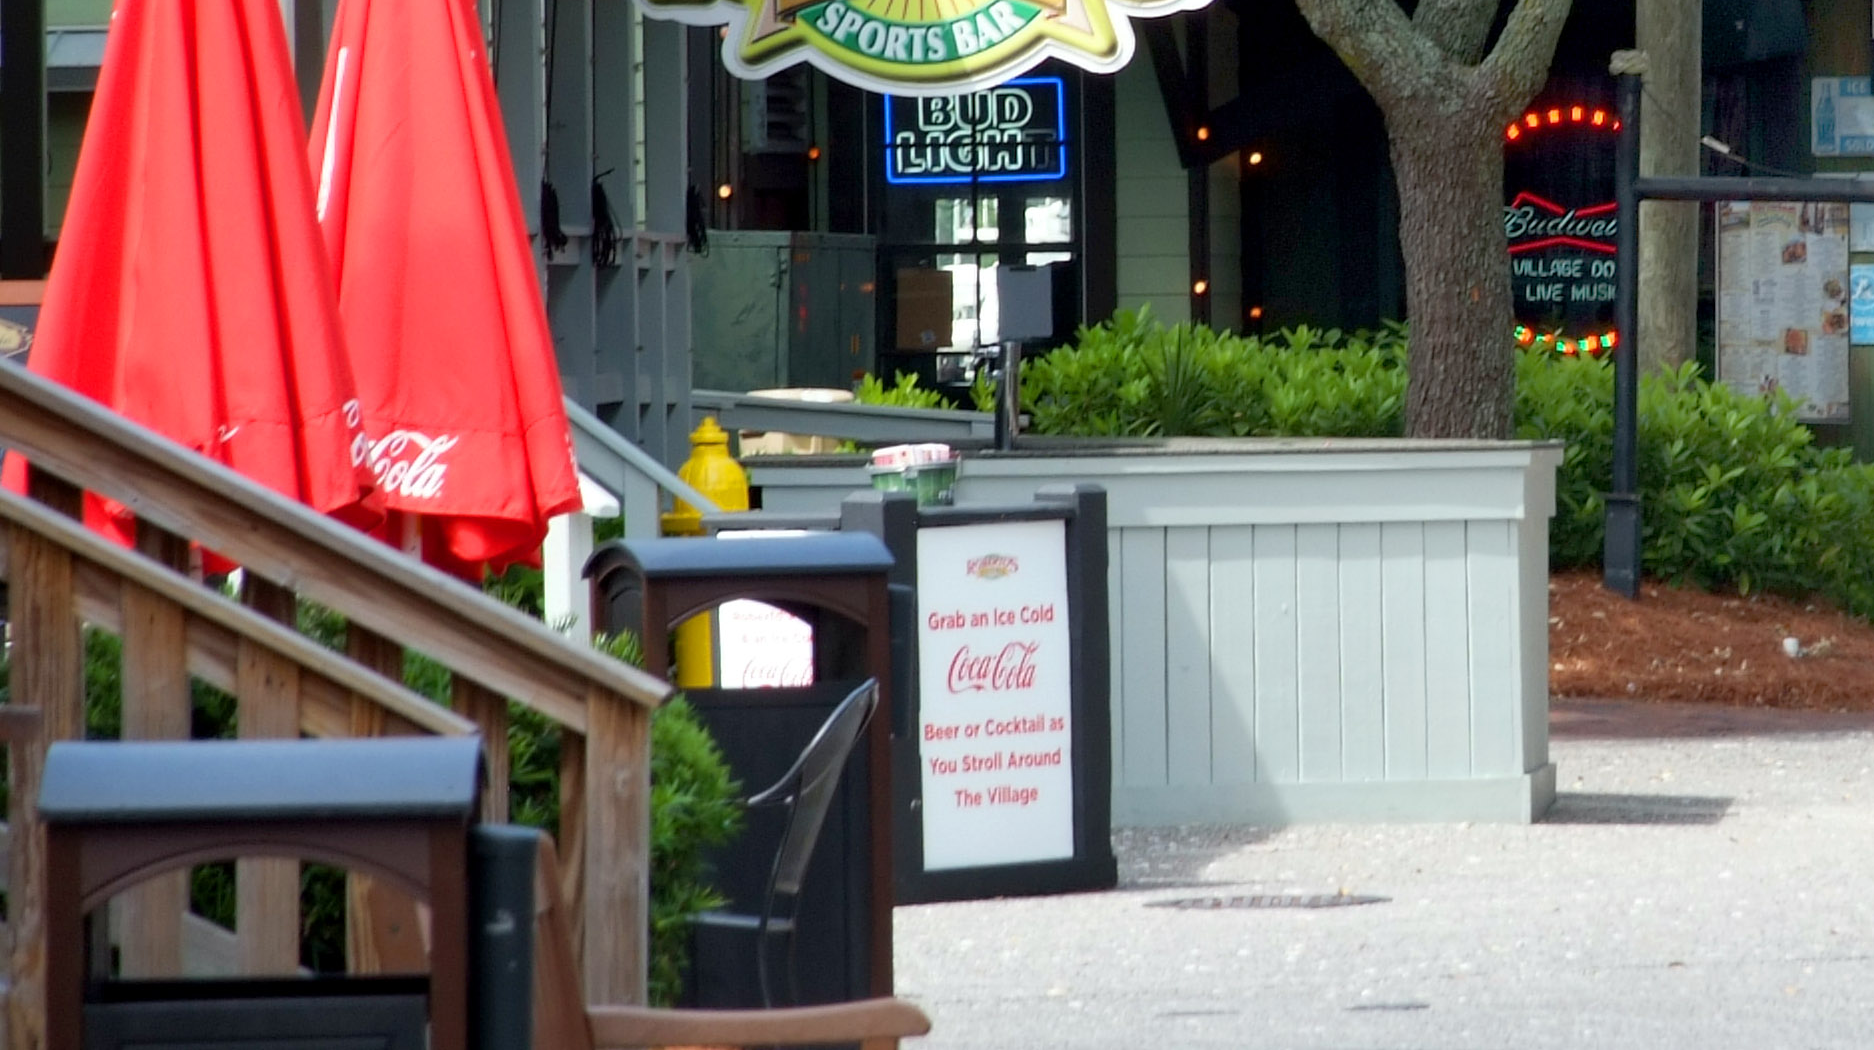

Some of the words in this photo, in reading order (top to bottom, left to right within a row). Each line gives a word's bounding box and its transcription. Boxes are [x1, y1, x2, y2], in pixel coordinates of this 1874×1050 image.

[816, 2, 946, 62] SPORTS
[953, 0, 1022, 54] BAR
[918, 88, 1033, 131] BUD
[1504, 206, 1617, 238] Budwei
[1513, 259, 1582, 278] VILLAGE
[1592, 260, 1616, 278] DO
[1526, 283, 1564, 301] LIVE
[928, 610, 965, 630] Grab
[970, 612, 989, 628] an
[994, 607, 1015, 626] Ice
[1020, 603, 1054, 624] Cold
[924, 723, 959, 741] Beer
[964, 724, 981, 738] or
[985, 714, 1045, 737] Cocktail
[1050, 716, 1065, 731] as
[930, 757, 957, 775] You
[962, 751, 1003, 772] Stroll
[1008, 748, 1062, 769] Around
[954, 788, 982, 808] The
[988, 784, 1039, 805] Village
